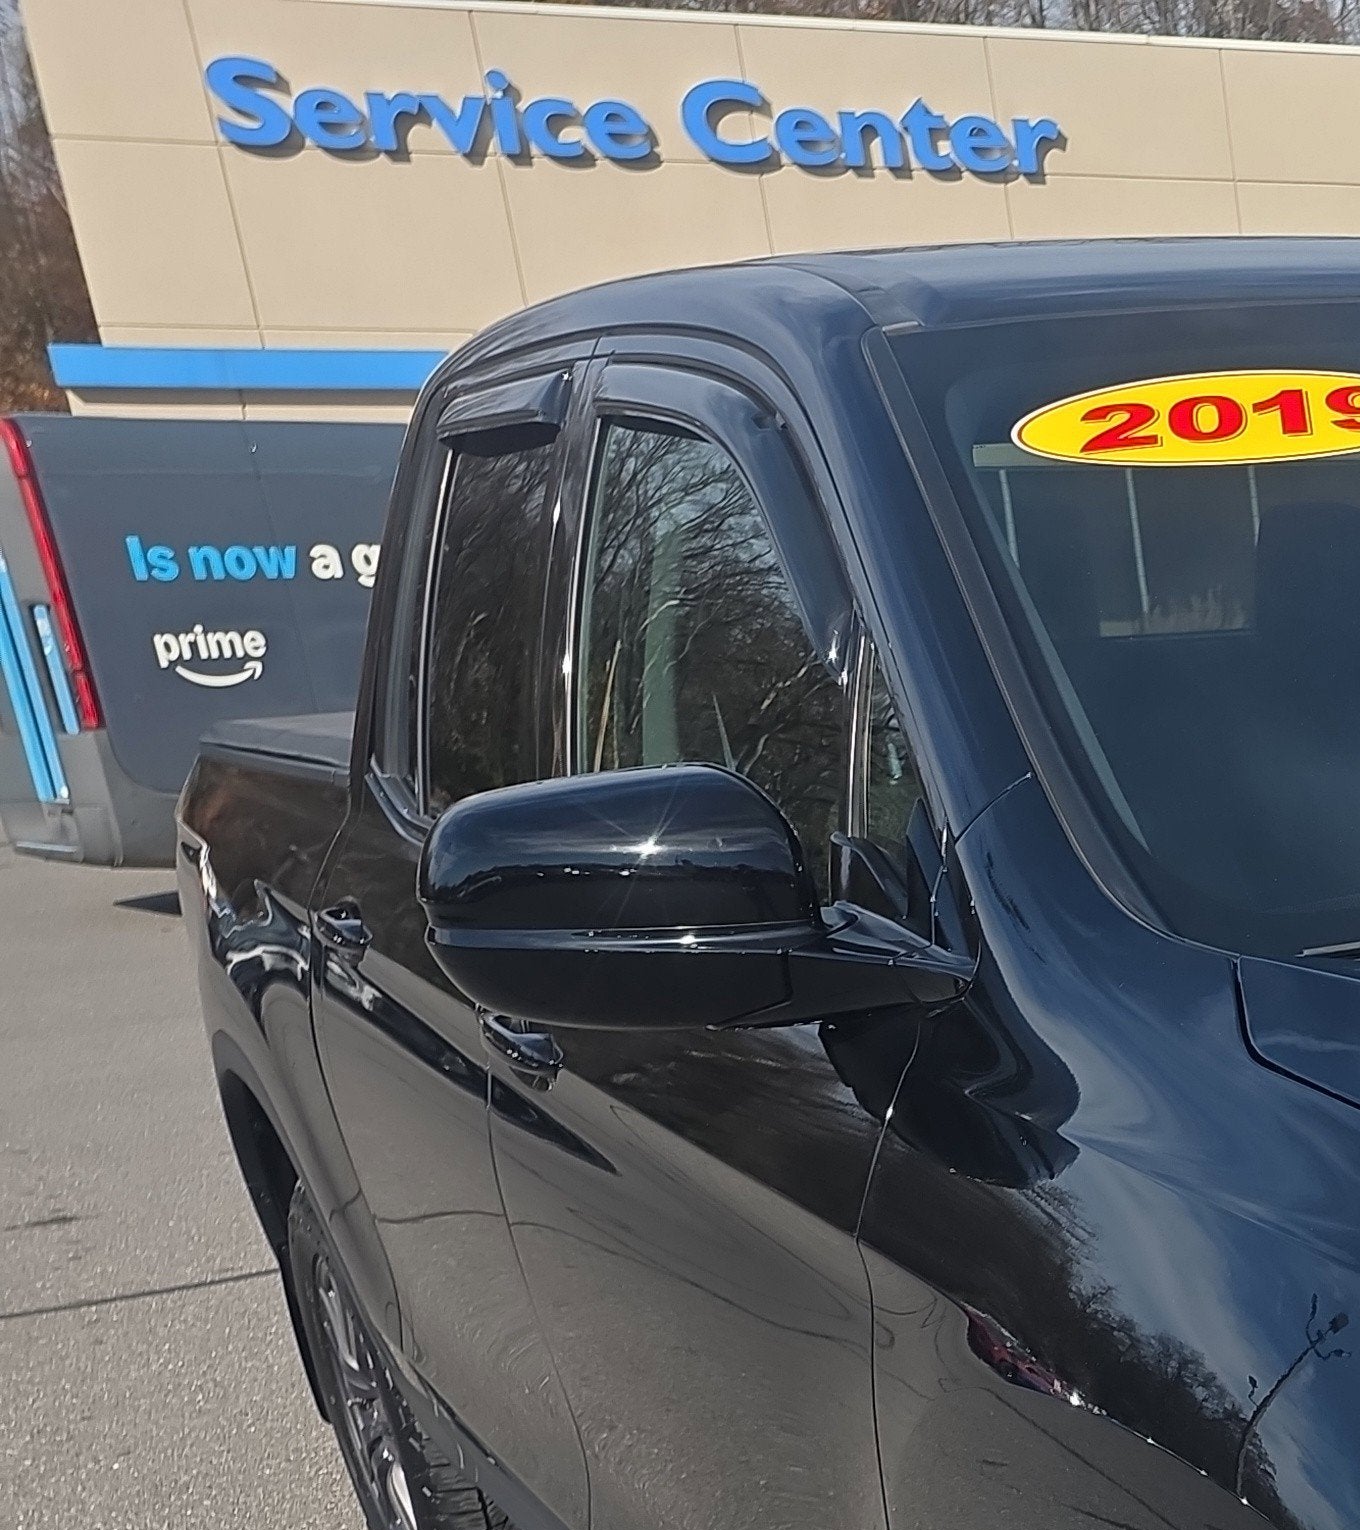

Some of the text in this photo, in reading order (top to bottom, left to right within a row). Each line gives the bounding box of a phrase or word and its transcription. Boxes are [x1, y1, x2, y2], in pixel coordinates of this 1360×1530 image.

[204, 56, 1064, 178] Service Center
[125, 534, 180, 582] Is
[187, 543, 297, 581] now
[308, 543, 344, 580] a
[153, 624, 267, 669] prime
